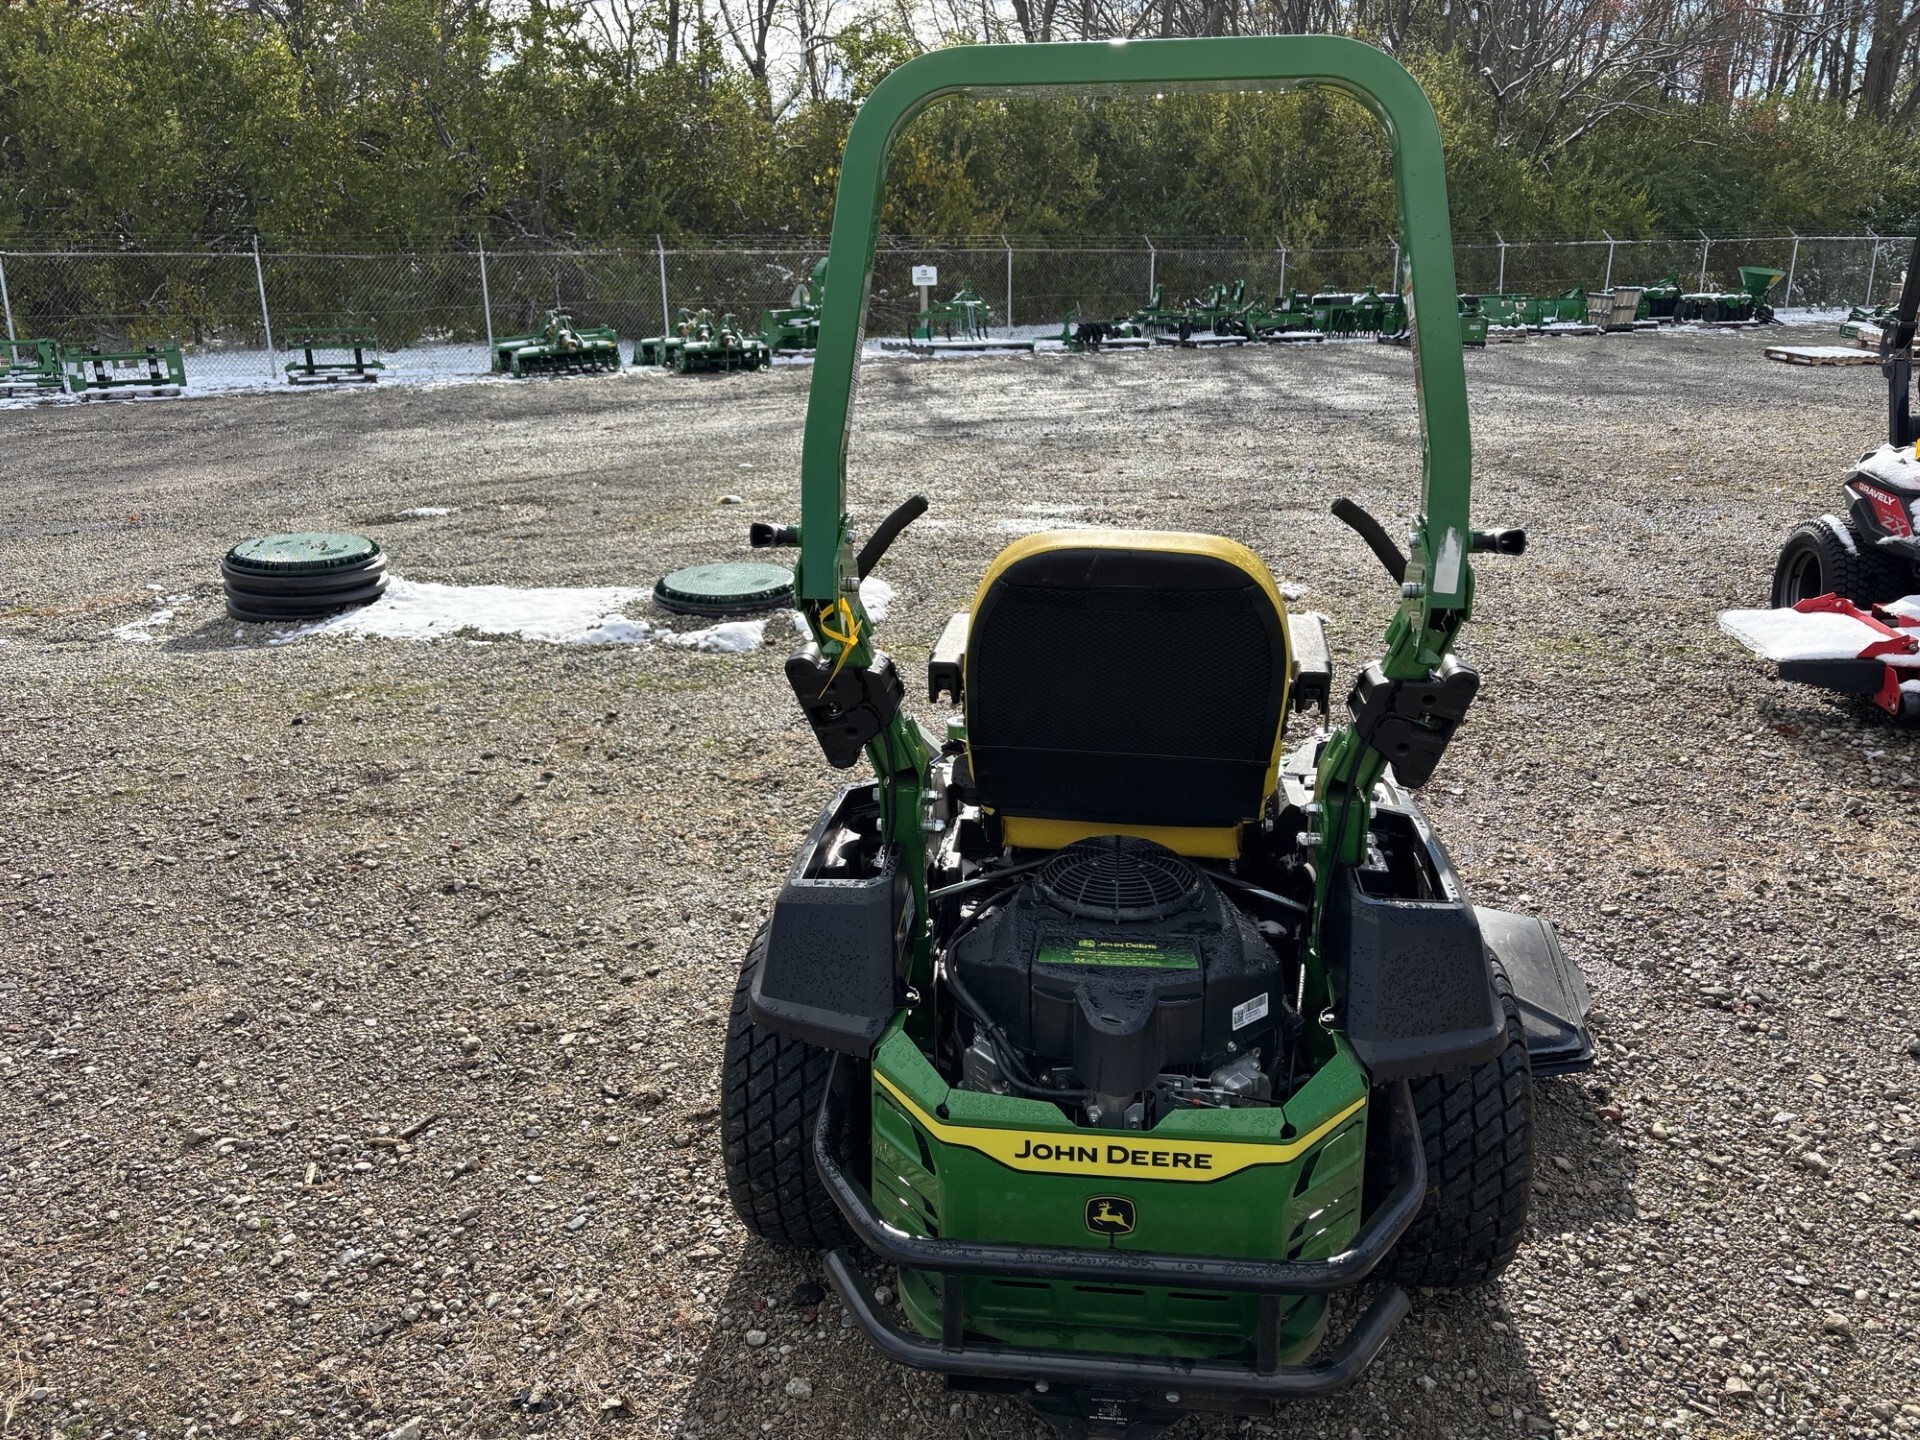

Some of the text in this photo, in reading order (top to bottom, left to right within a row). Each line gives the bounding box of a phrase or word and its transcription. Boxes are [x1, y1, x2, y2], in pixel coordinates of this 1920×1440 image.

[1859, 482, 1896, 505] GRAVELY
[1881, 515, 1907, 536] ZX
[1014, 1139, 1213, 1170] JOHN DEERE
